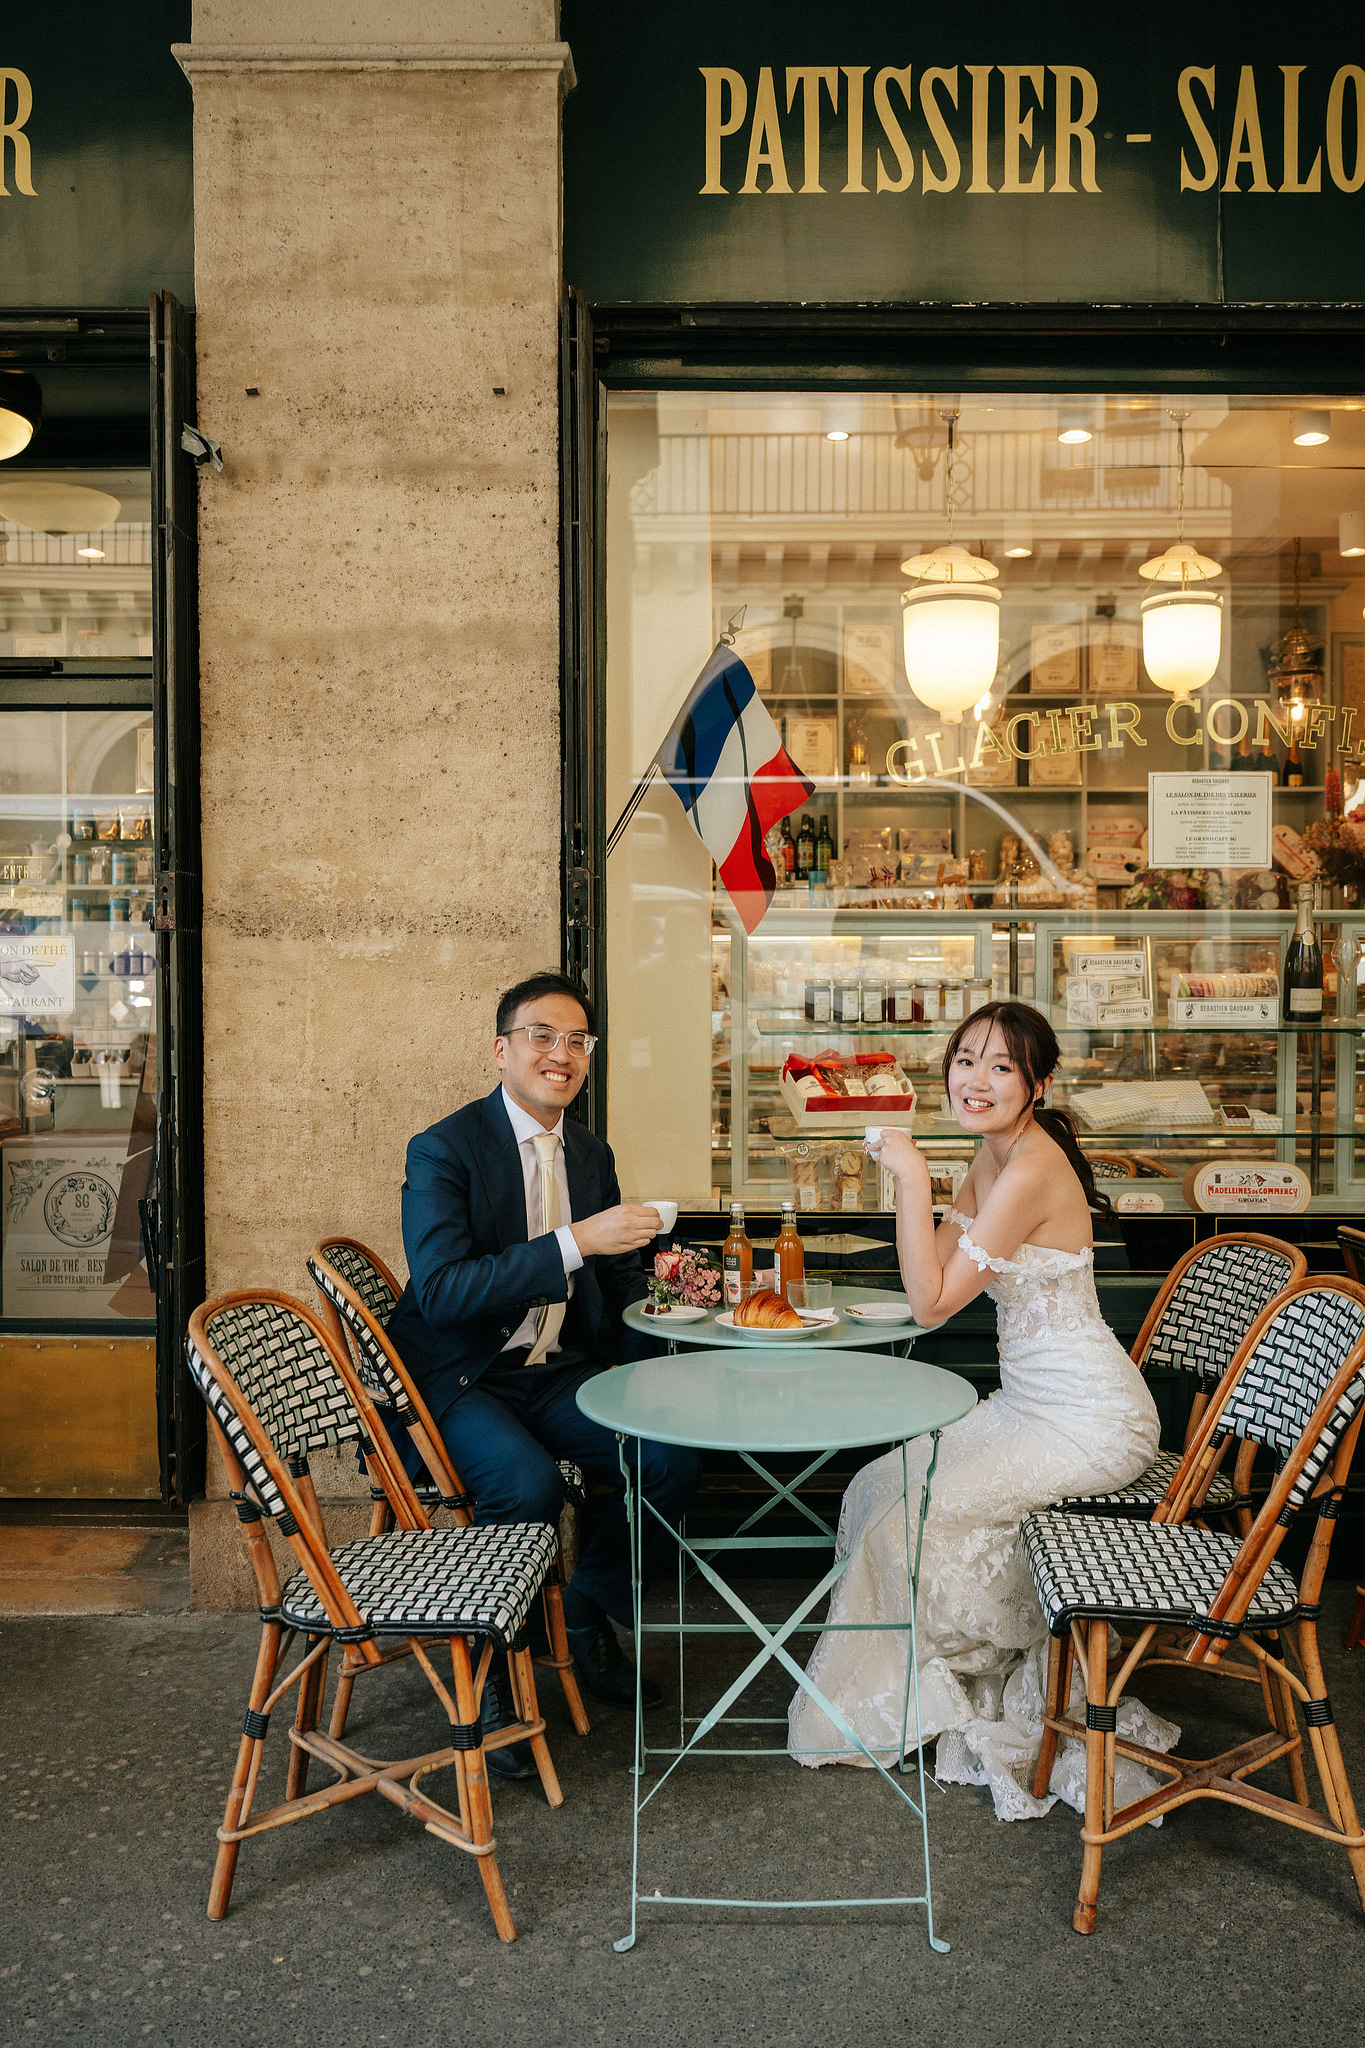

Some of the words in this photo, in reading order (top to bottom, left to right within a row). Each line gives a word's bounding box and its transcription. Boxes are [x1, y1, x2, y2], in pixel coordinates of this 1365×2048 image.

[698, 64, 1102, 195] PATISSIER
[1177, 64, 1365, 194] SALO
[886, 702, 1147, 786] GLACIER
[1166, 699, 1365, 756] CONFI
[22, 945, 39, 955] DE
[41, 944, 68, 955] THÉ
[1207, 1185, 1251, 1196] MADELEINES
[1259, 1187, 1298, 1197] COMMERCY
[75, 1193, 90, 1208] SG
[20, 1259, 47, 1272] SALON
[50, 1259, 61, 1272] DE
[62, 1258, 80, 1272] THÉ
[53, 1275, 64, 1284] DES
[65, 1275, 96, 1284] PYRAMIDES
